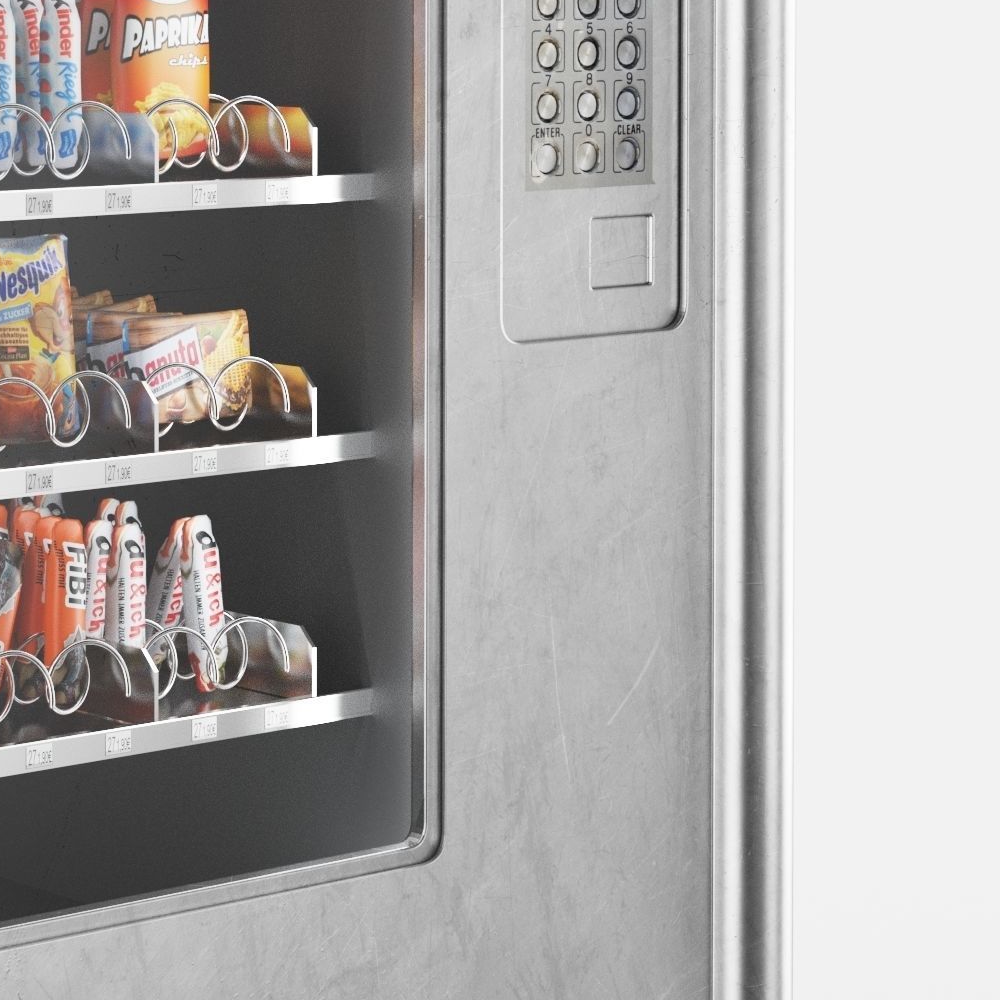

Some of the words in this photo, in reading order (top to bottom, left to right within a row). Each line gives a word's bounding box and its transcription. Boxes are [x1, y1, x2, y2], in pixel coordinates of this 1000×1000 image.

[545, 23, 552, 35] 4
[587, 23, 593, 35] 5
[627, 22, 633, 34] 6
[545, 75, 552, 87] 7
[587, 73, 593, 85] 8
[627, 72, 633, 84] 9
[535, 127, 560, 139] ENTER
[617, 124, 641, 136] CLEAR
[130, 583, 145, 599] &
